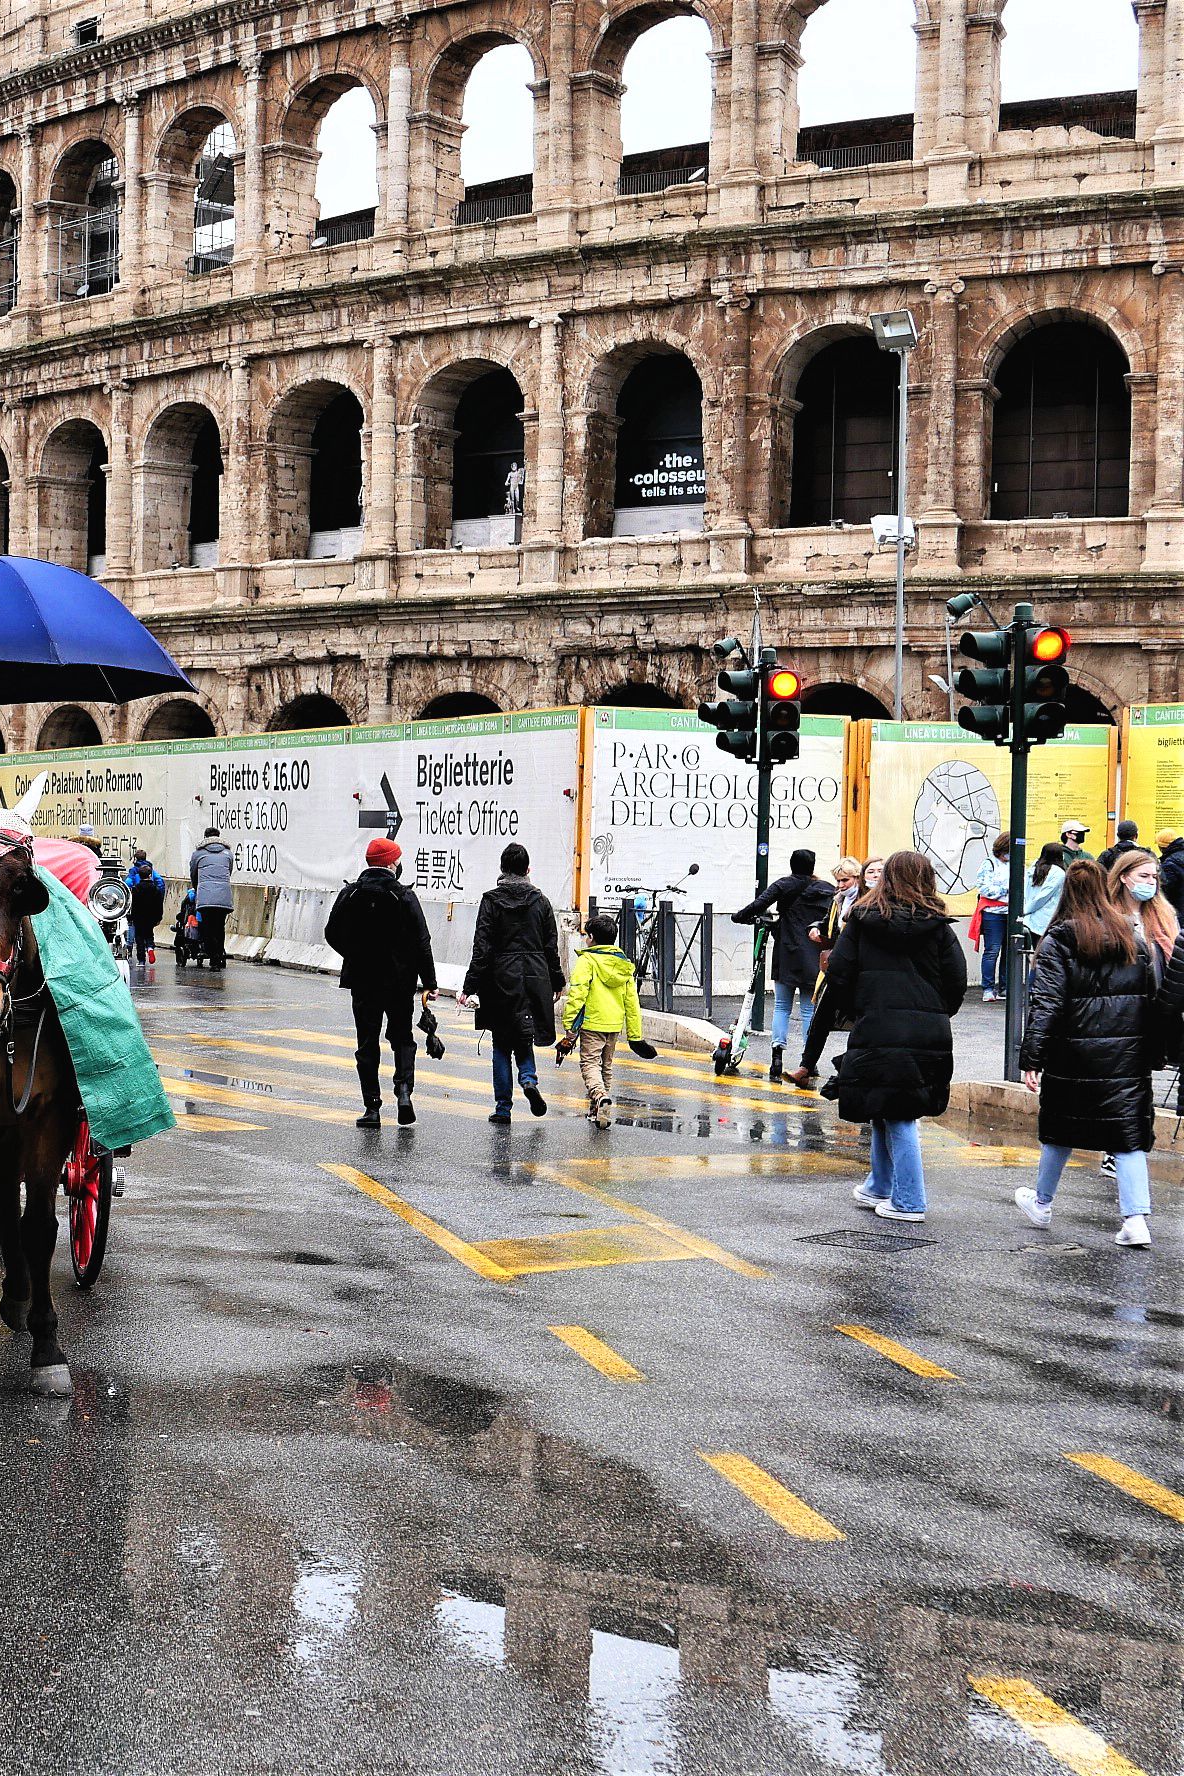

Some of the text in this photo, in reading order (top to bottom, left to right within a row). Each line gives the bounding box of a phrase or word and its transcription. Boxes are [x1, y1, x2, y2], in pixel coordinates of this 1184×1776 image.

[641, 486, 707, 498] tells its sto
[904, 727, 931, 739] LINEA
[940, 728, 966, 739] DELLA
[51, 771, 84, 795] Palatino
[85, 769, 104, 793] Foro
[105, 767, 143, 792] Romano
[210, 760, 310, 797] Biglietto € 16.00
[417, 750, 514, 795] Biglietterie
[56, 803, 86, 826] Palatine
[88, 801, 101, 825] Hill
[102, 804, 133, 826] Roman
[134, 800, 164, 826] Forum
[209, 801, 288, 831] Ticket € 16.00
[416, 800, 519, 836] Ticket Office
[610, 800, 663, 827] DEL
[235, 842, 277, 874] € 16.00
[415, 847, 464, 891] 售票处
